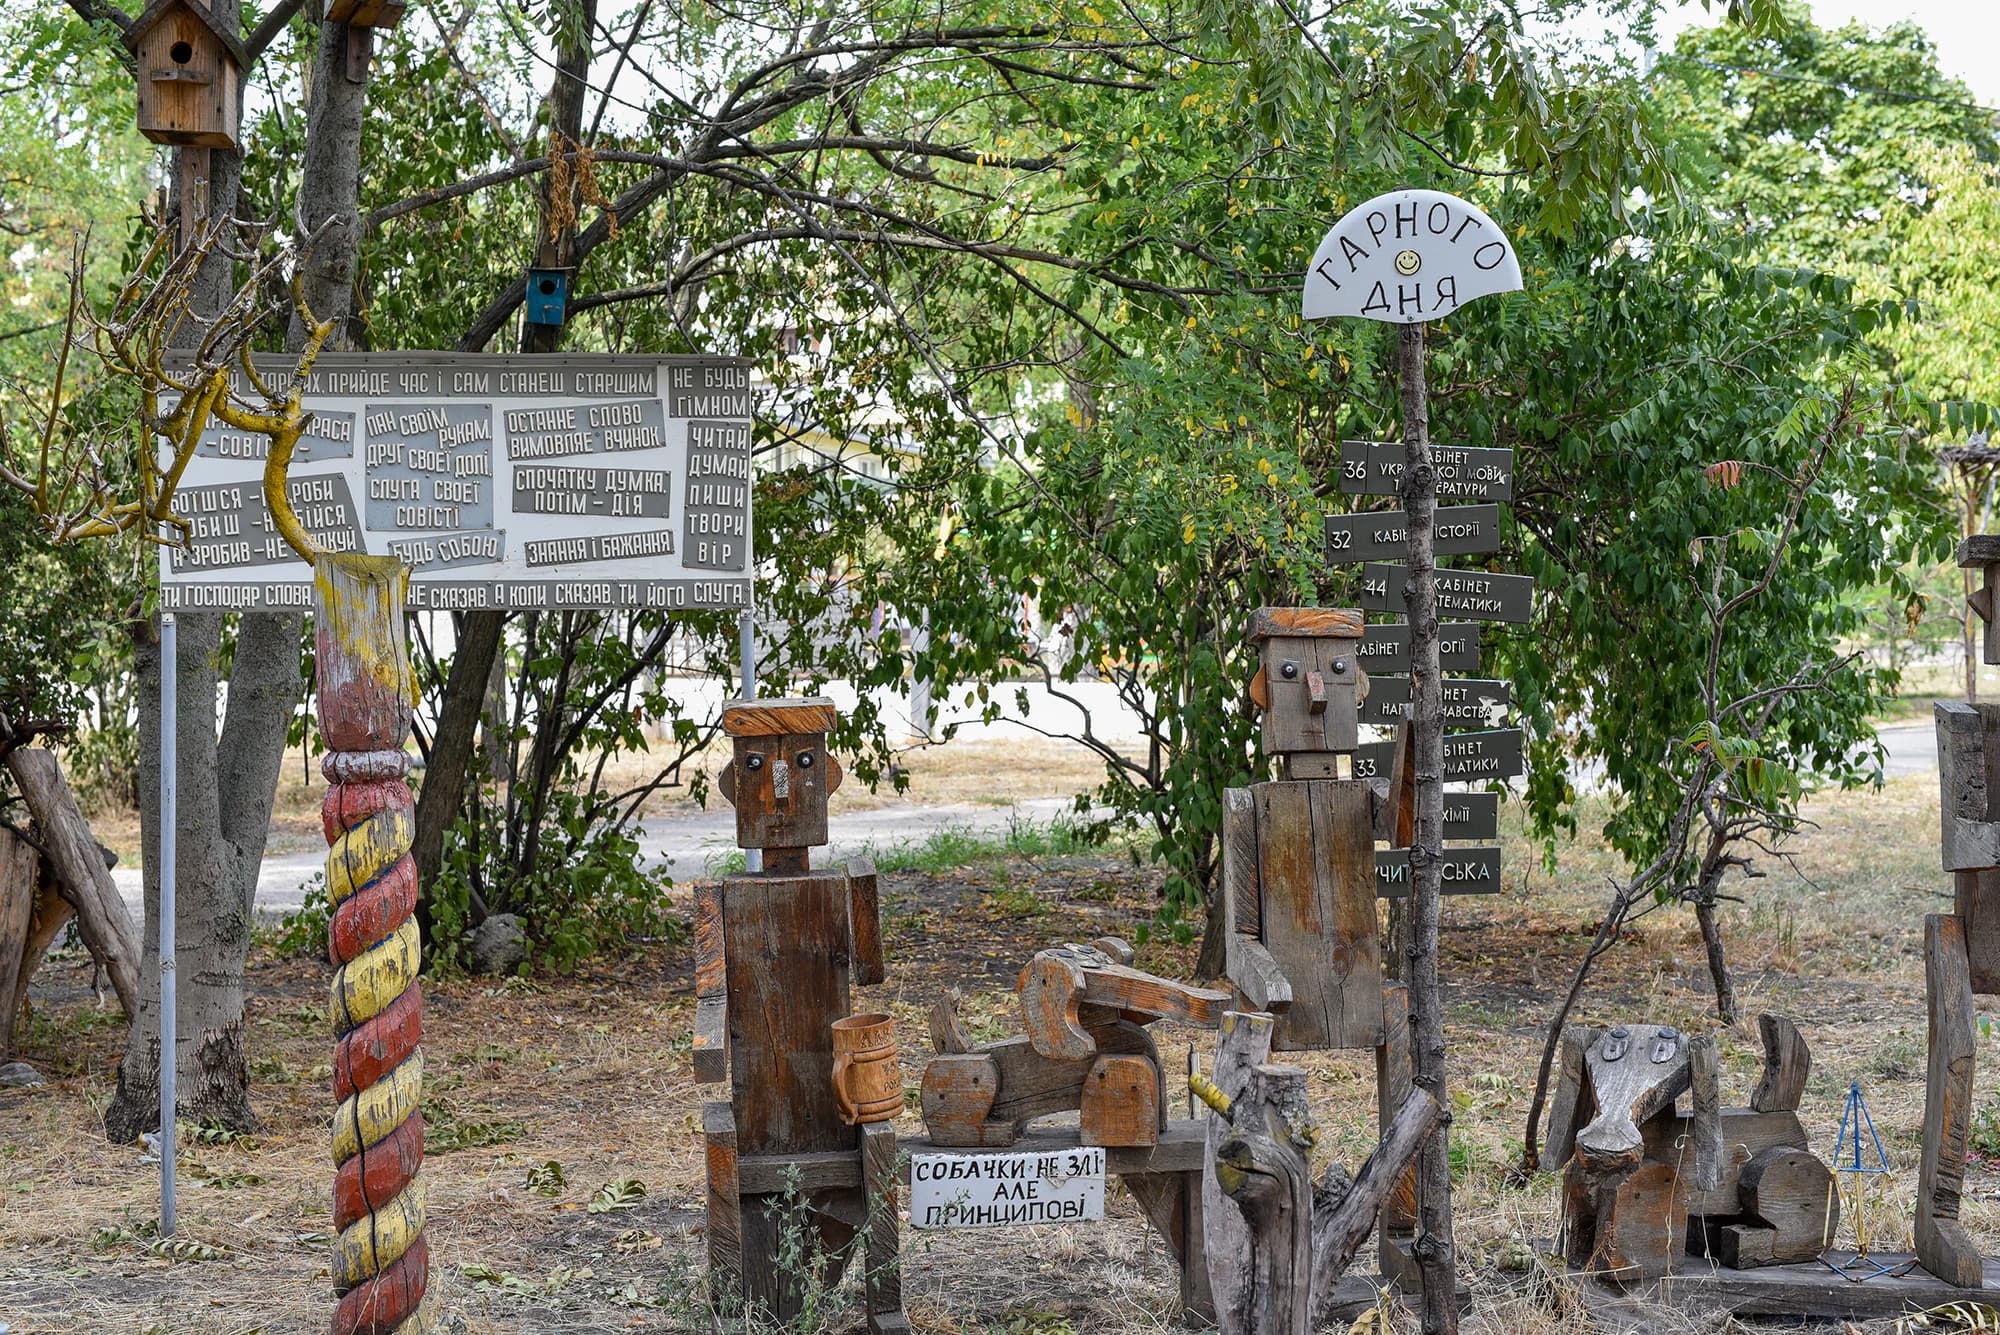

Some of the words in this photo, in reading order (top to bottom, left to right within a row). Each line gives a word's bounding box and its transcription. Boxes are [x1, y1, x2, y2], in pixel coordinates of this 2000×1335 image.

[1316, 202, 1506, 291] ГАРНОГО
[1361, 275, 1458, 315] ДНЯ
[329, 371, 390, 395] ПРИЙДЕ
[400, 373, 429, 394] ЧАС
[453, 372, 489, 393] САМ
[500, 372, 564, 393] СТАНЕШ
[575, 372, 652, 394] СТАРШИМ
[674, 368, 693, 388] НЕ
[705, 367, 746, 390] БУДЬ
[366, 411, 397, 437] ПАН
[400, 407, 449, 436] СВОЇМ
[508, 408, 576, 433] ОСТАННЕ
[589, 403, 642, 428] СЛОВО
[604, 426, 660, 450] ВЧИНОК
[692, 425, 747, 450] ЧИТАЙ
[367, 443, 405, 467] ДРУГ
[689, 454, 748, 480] ДУМАЙ
[1429, 450, 1470, 464] АБІНЕТ
[516, 468, 597, 490] СПОЧАТКУ
[1345, 461, 1366, 479] 36
[292, 480, 334, 504] РОБИ
[370, 479, 420, 500] СЛУГА
[690, 484, 744, 508] ПИШИ
[688, 513, 744, 537] ТВОРИ
[393, 541, 434, 565] БУДЬ
[438, 535, 497, 562] СОБОЮ
[527, 542, 587, 564] ЗНАННЯ
[602, 532, 670, 558] БАЖАННЯ
[1331, 530, 1352, 549] 32
[191, 541, 250, 566] ЗРОБИВ
[162, 587, 180, 607] ТИ
[185, 585, 260, 608] ГОСПОДАР
[407, 584, 427, 606] НЕ
[495, 583, 505, 604] А
[510, 584, 547, 607] КОЛИ
[619, 584, 637, 602] ТИ
[647, 582, 685, 606] ЙОГО
[1365, 579, 1387, 597] 44
[1443, 741, 1482, 757] БІНЕТ
[1356, 759, 1376, 776] 33
[916, 1159, 1025, 1182] СОБАЧКИ
[1036, 1157, 1059, 1179] НЕ
[993, 1180, 1039, 1201] АЛЕ
[924, 1193, 1086, 1226] ПРИНЦИПОВІ
